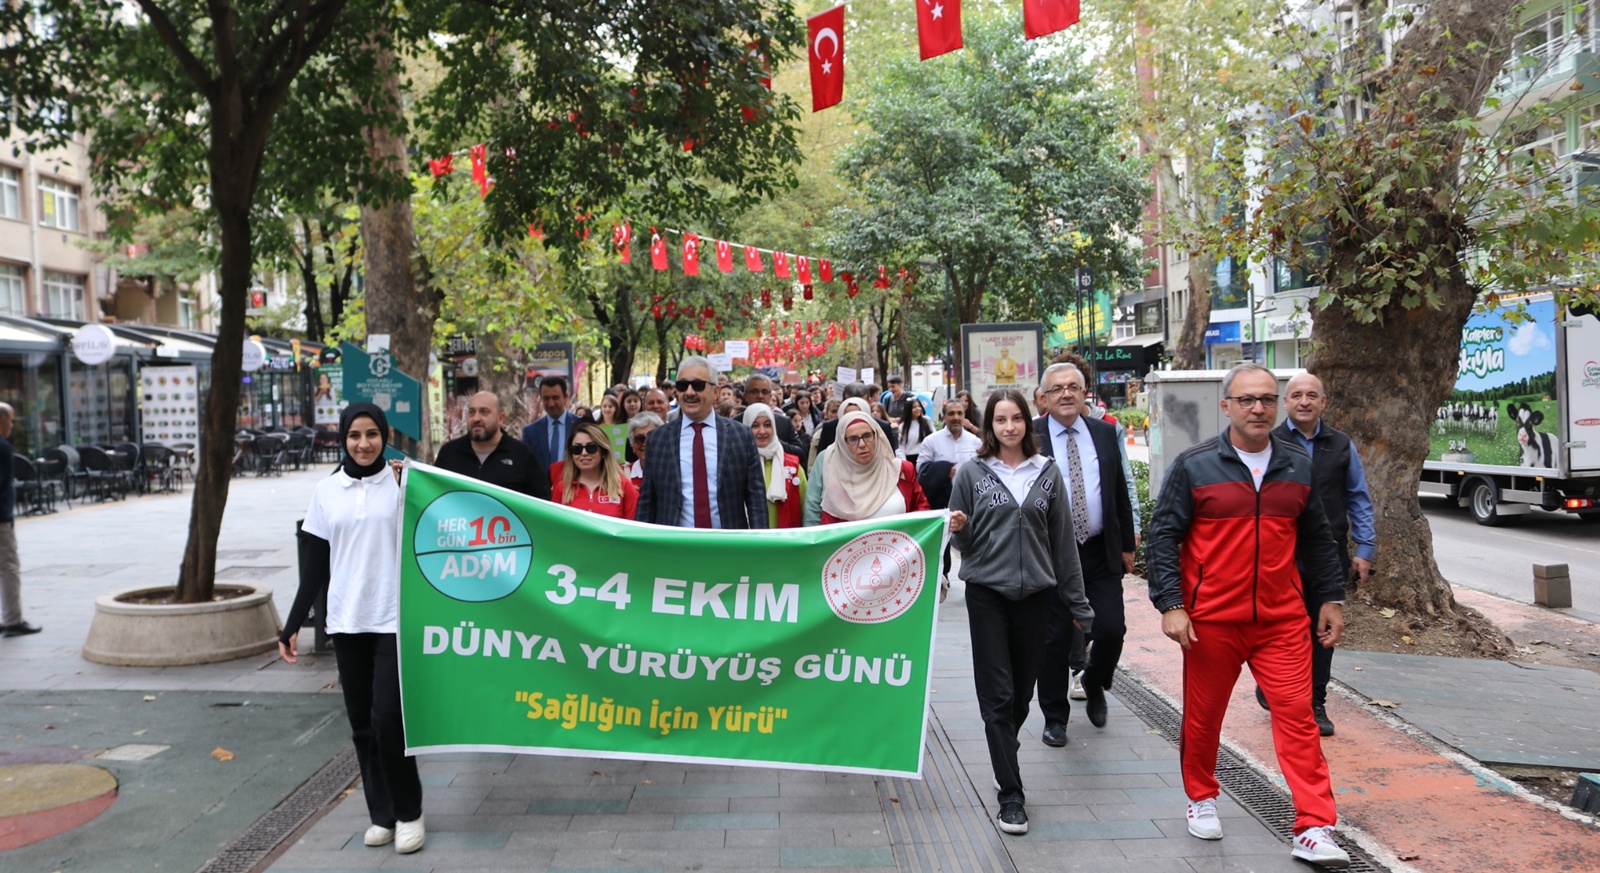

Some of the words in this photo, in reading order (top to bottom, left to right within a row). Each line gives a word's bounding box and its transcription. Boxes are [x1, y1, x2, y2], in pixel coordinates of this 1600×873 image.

[1104, 349, 1114, 360] La
[1116, 348, 1132, 360] Rue
[437, 517, 467, 532] HER
[468, 515, 511, 547] 10
[437, 533, 466, 547] GÜN
[498, 533, 517, 544] bin
[544, 563, 631, 610] 3-4
[651, 575, 800, 623] EKİM
[422, 620, 567, 664] DÜNYA
[579, 643, 782, 686] YÜRÜYÜŞ
[794, 648, 912, 687] GÜNÜ
[515, 690, 641, 732] "Sağlığın
[649, 699, 699, 735] İçin
[707, 705, 788, 734] Yürü"
